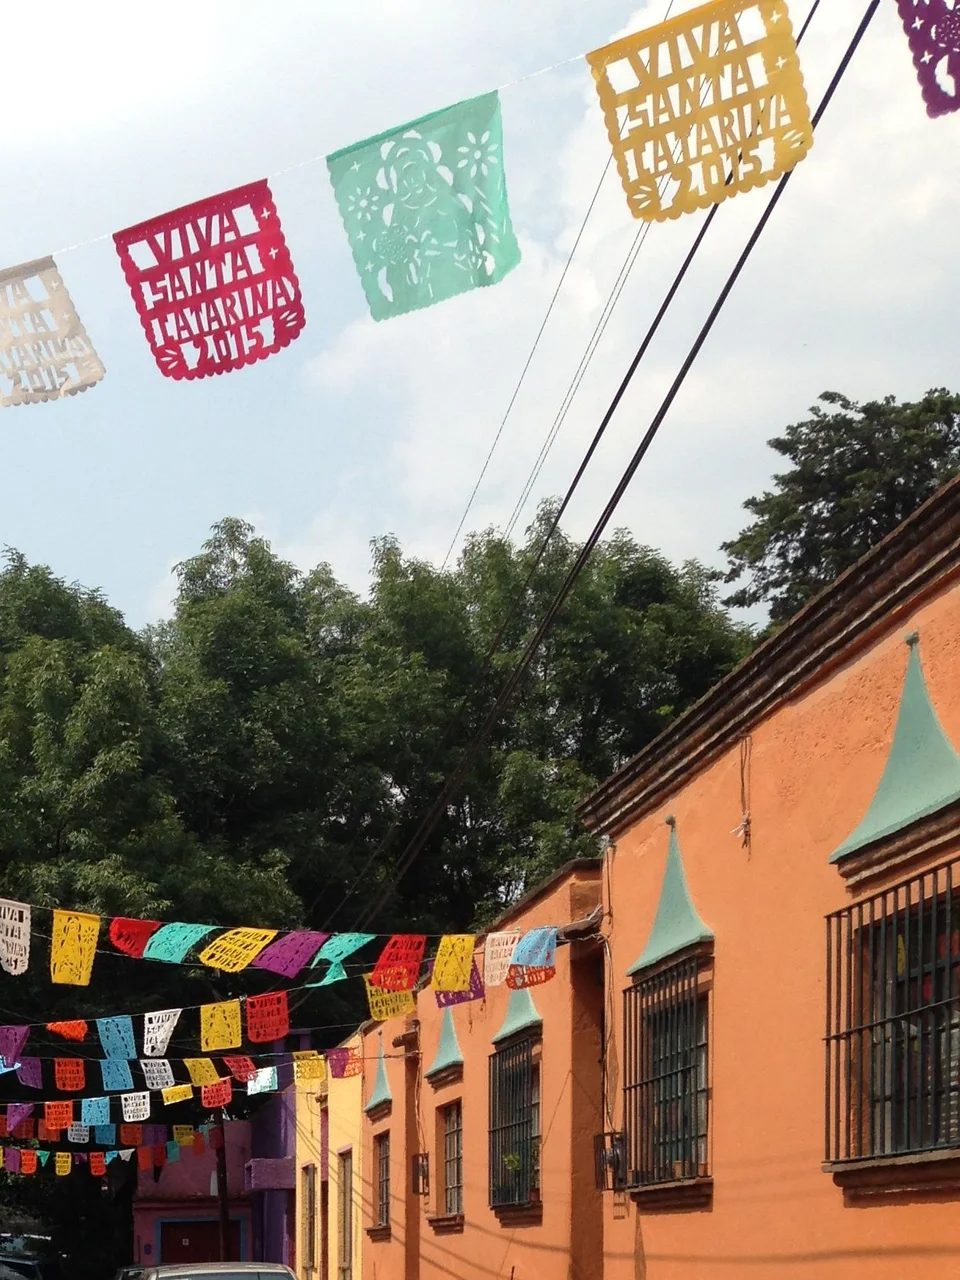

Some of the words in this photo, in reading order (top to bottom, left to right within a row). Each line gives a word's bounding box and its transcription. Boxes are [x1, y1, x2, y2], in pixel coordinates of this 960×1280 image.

[628, 17, 744, 84] VIVA
[627, 57, 754, 135] SANTA
[147, 210, 244, 266] VIVA
[147, 248, 253, 306] SANTA
